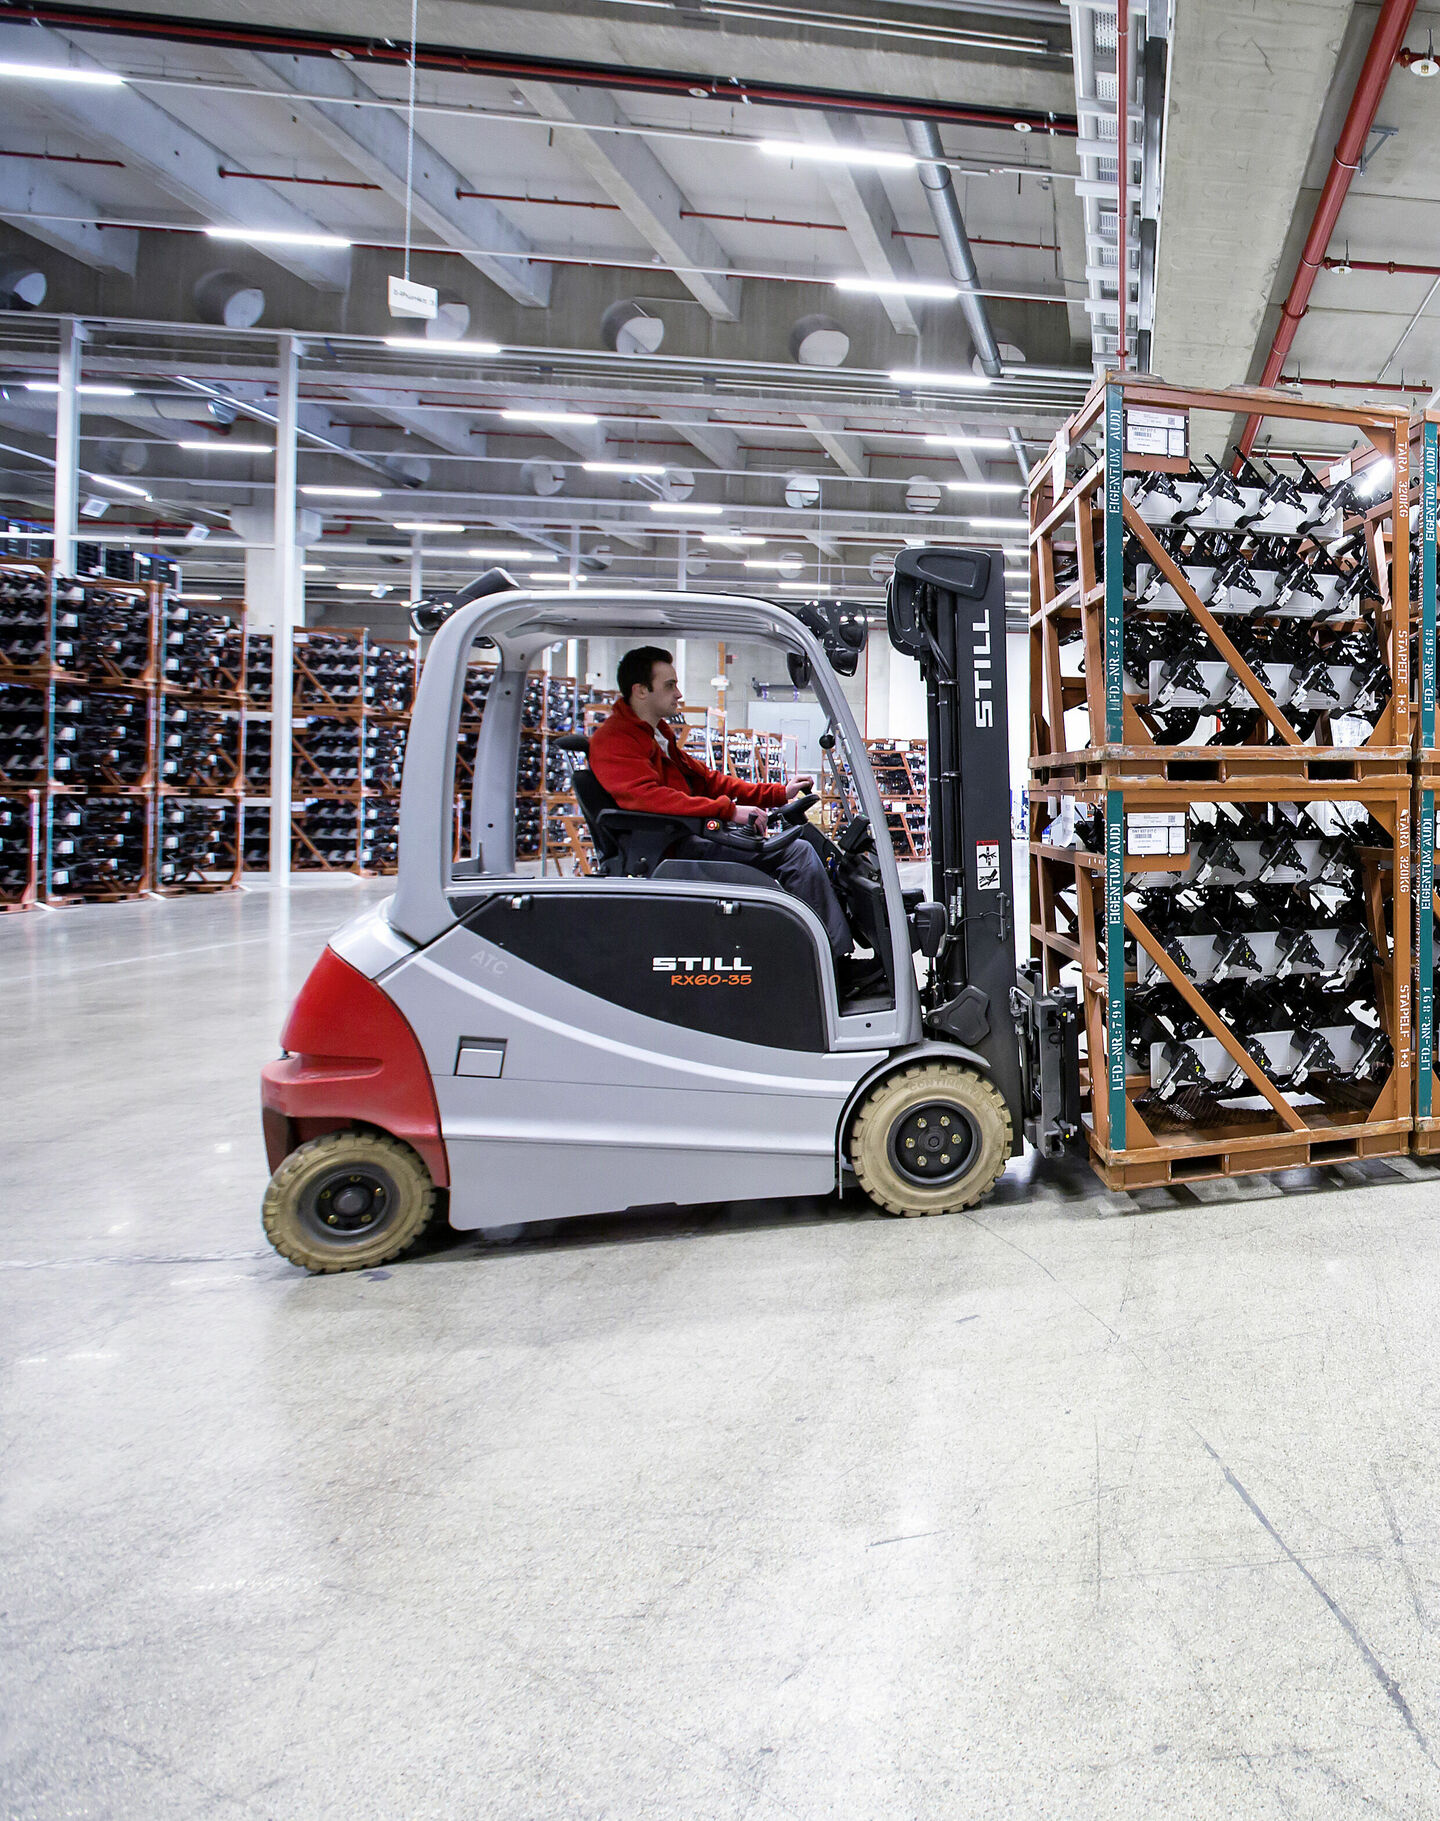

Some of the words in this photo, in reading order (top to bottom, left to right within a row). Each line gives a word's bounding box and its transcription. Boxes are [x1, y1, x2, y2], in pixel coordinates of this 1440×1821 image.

[1109, 409, 1121, 441] AUDI
[1397, 441, 1409, 472] TARA
[1427, 446, 1437, 476] AUDI
[1108, 447, 1121, 514] EIGENTUM
[1397, 480, 1409, 518] 320KG
[1425, 481, 1436, 542] EIGENTUM
[972, 609, 993, 728] STILL
[1397, 694, 1409, 715] 1+3
[1110, 823, 1121, 855] AUDI
[1399, 817, 1409, 849] TARA
[1422, 818, 1433, 847] AUDI
[1400, 856, 1410, 893] 320KG
[1421, 850, 1433, 910] EIGENTUM
[1109, 858, 1121, 925] EIGENTUM
[471, 950, 508, 975] ATC
[652, 957, 753, 971] STILL
[671, 974, 753, 986] RX60-35
[1398, 1047, 1410, 1068] 1+3
